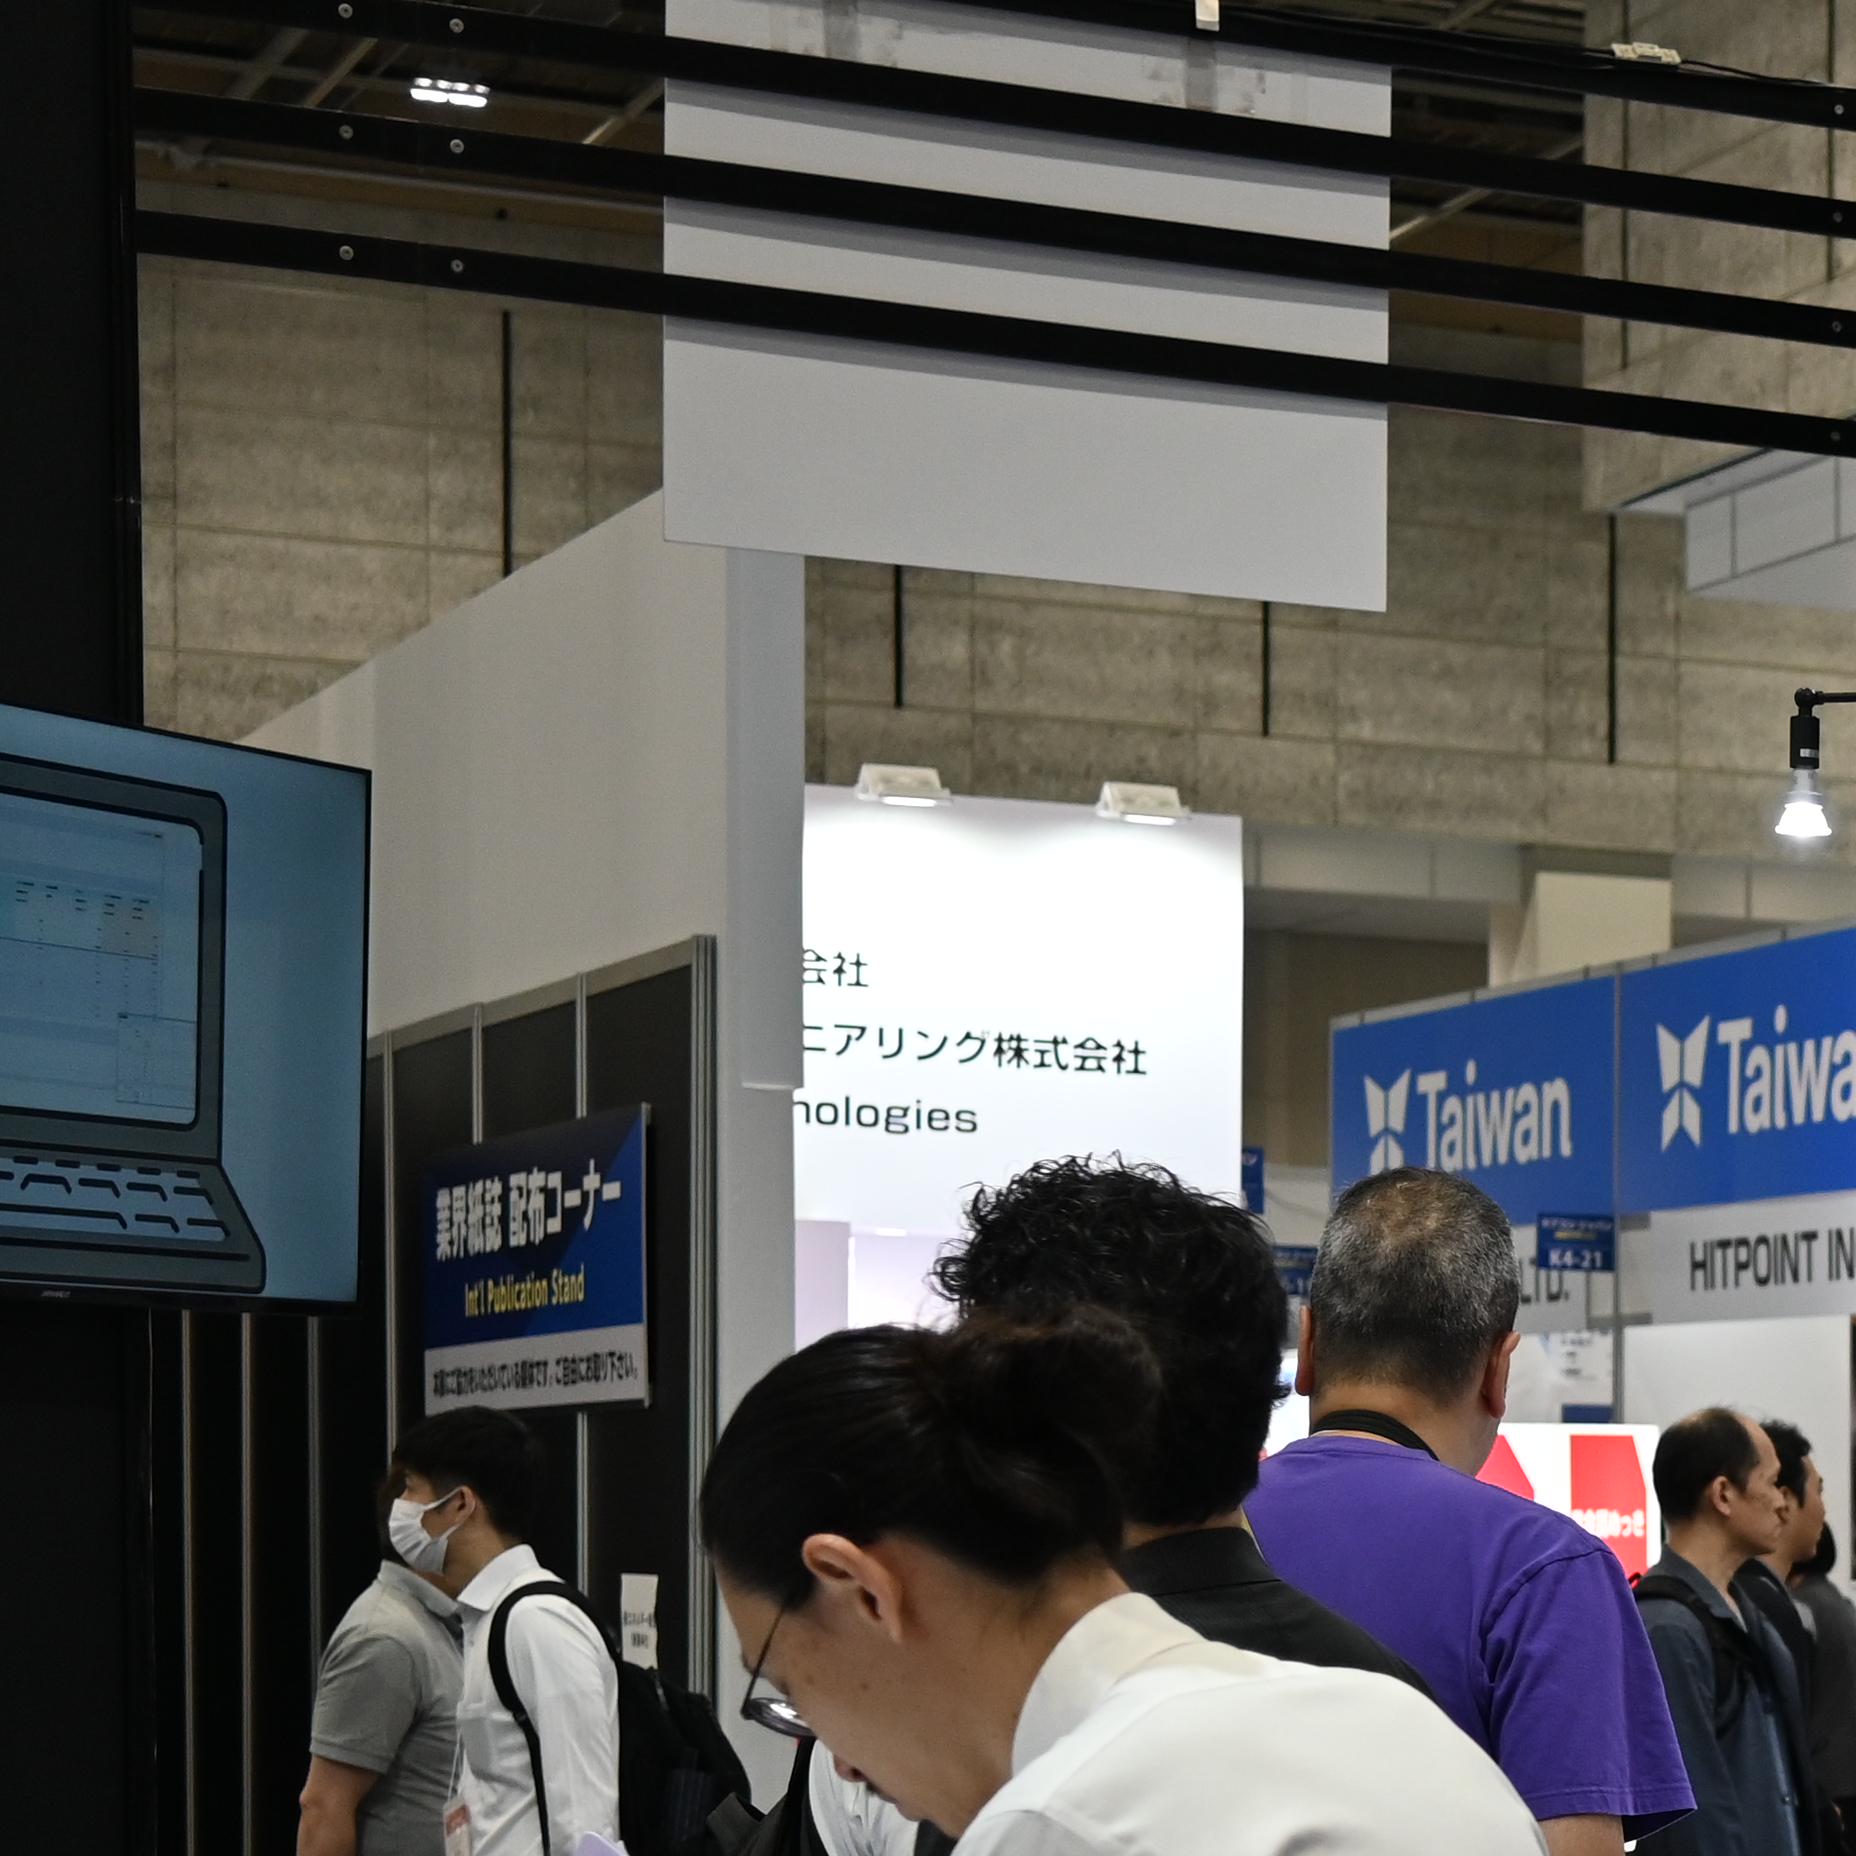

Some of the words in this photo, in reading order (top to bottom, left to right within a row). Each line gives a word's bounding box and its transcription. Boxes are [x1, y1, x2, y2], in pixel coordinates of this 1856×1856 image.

[1417, 1058, 1573, 1174] Taiwan
[508, 1158, 622, 1248] 配布コーナー
[488, 1271, 548, 1313] Publication
[551, 1262, 585, 1305] Stand
[1690, 1231, 1818, 1292] HITPOINT
